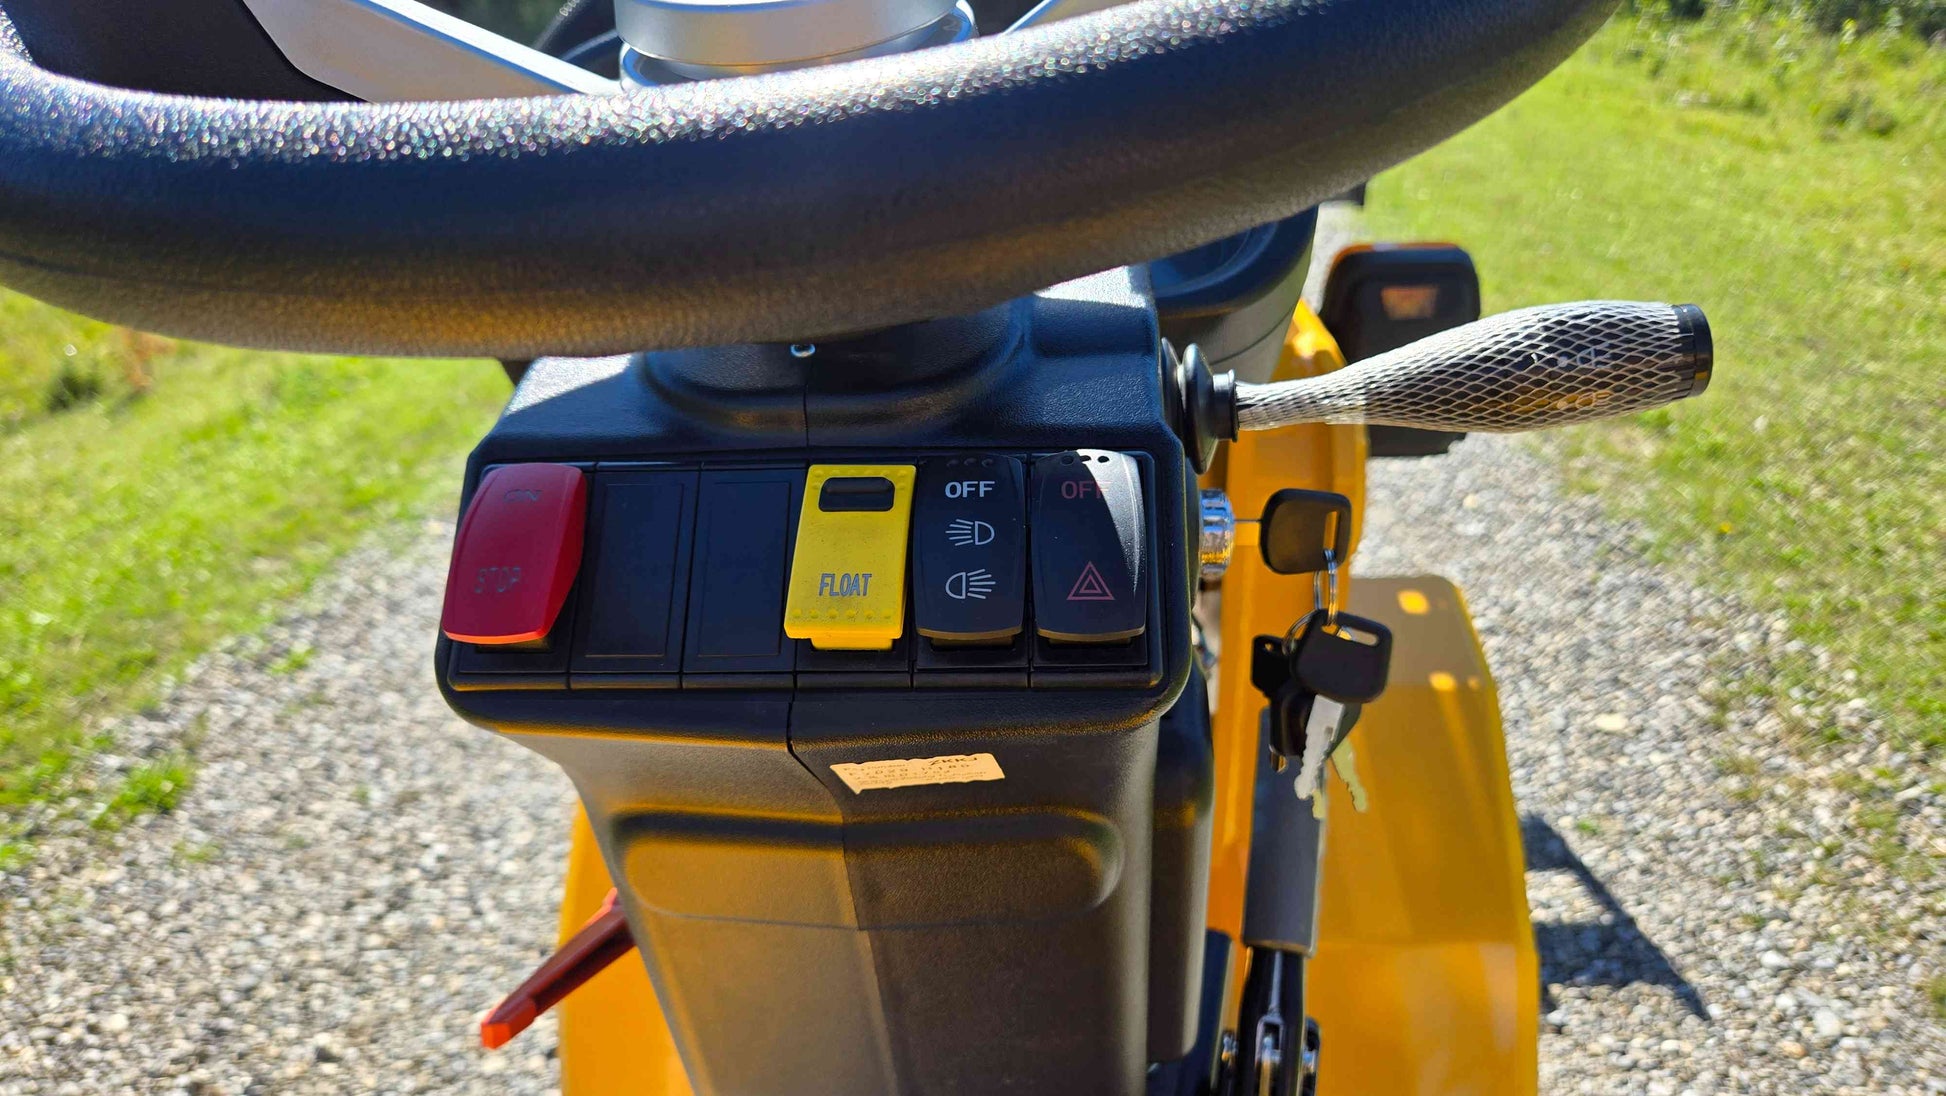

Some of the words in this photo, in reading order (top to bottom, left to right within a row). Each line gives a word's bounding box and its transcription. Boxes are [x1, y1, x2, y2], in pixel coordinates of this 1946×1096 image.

[945, 481, 996, 498] OFF
[474, 566, 521, 593] STOP
[819, 573, 872, 597] FLOAT
